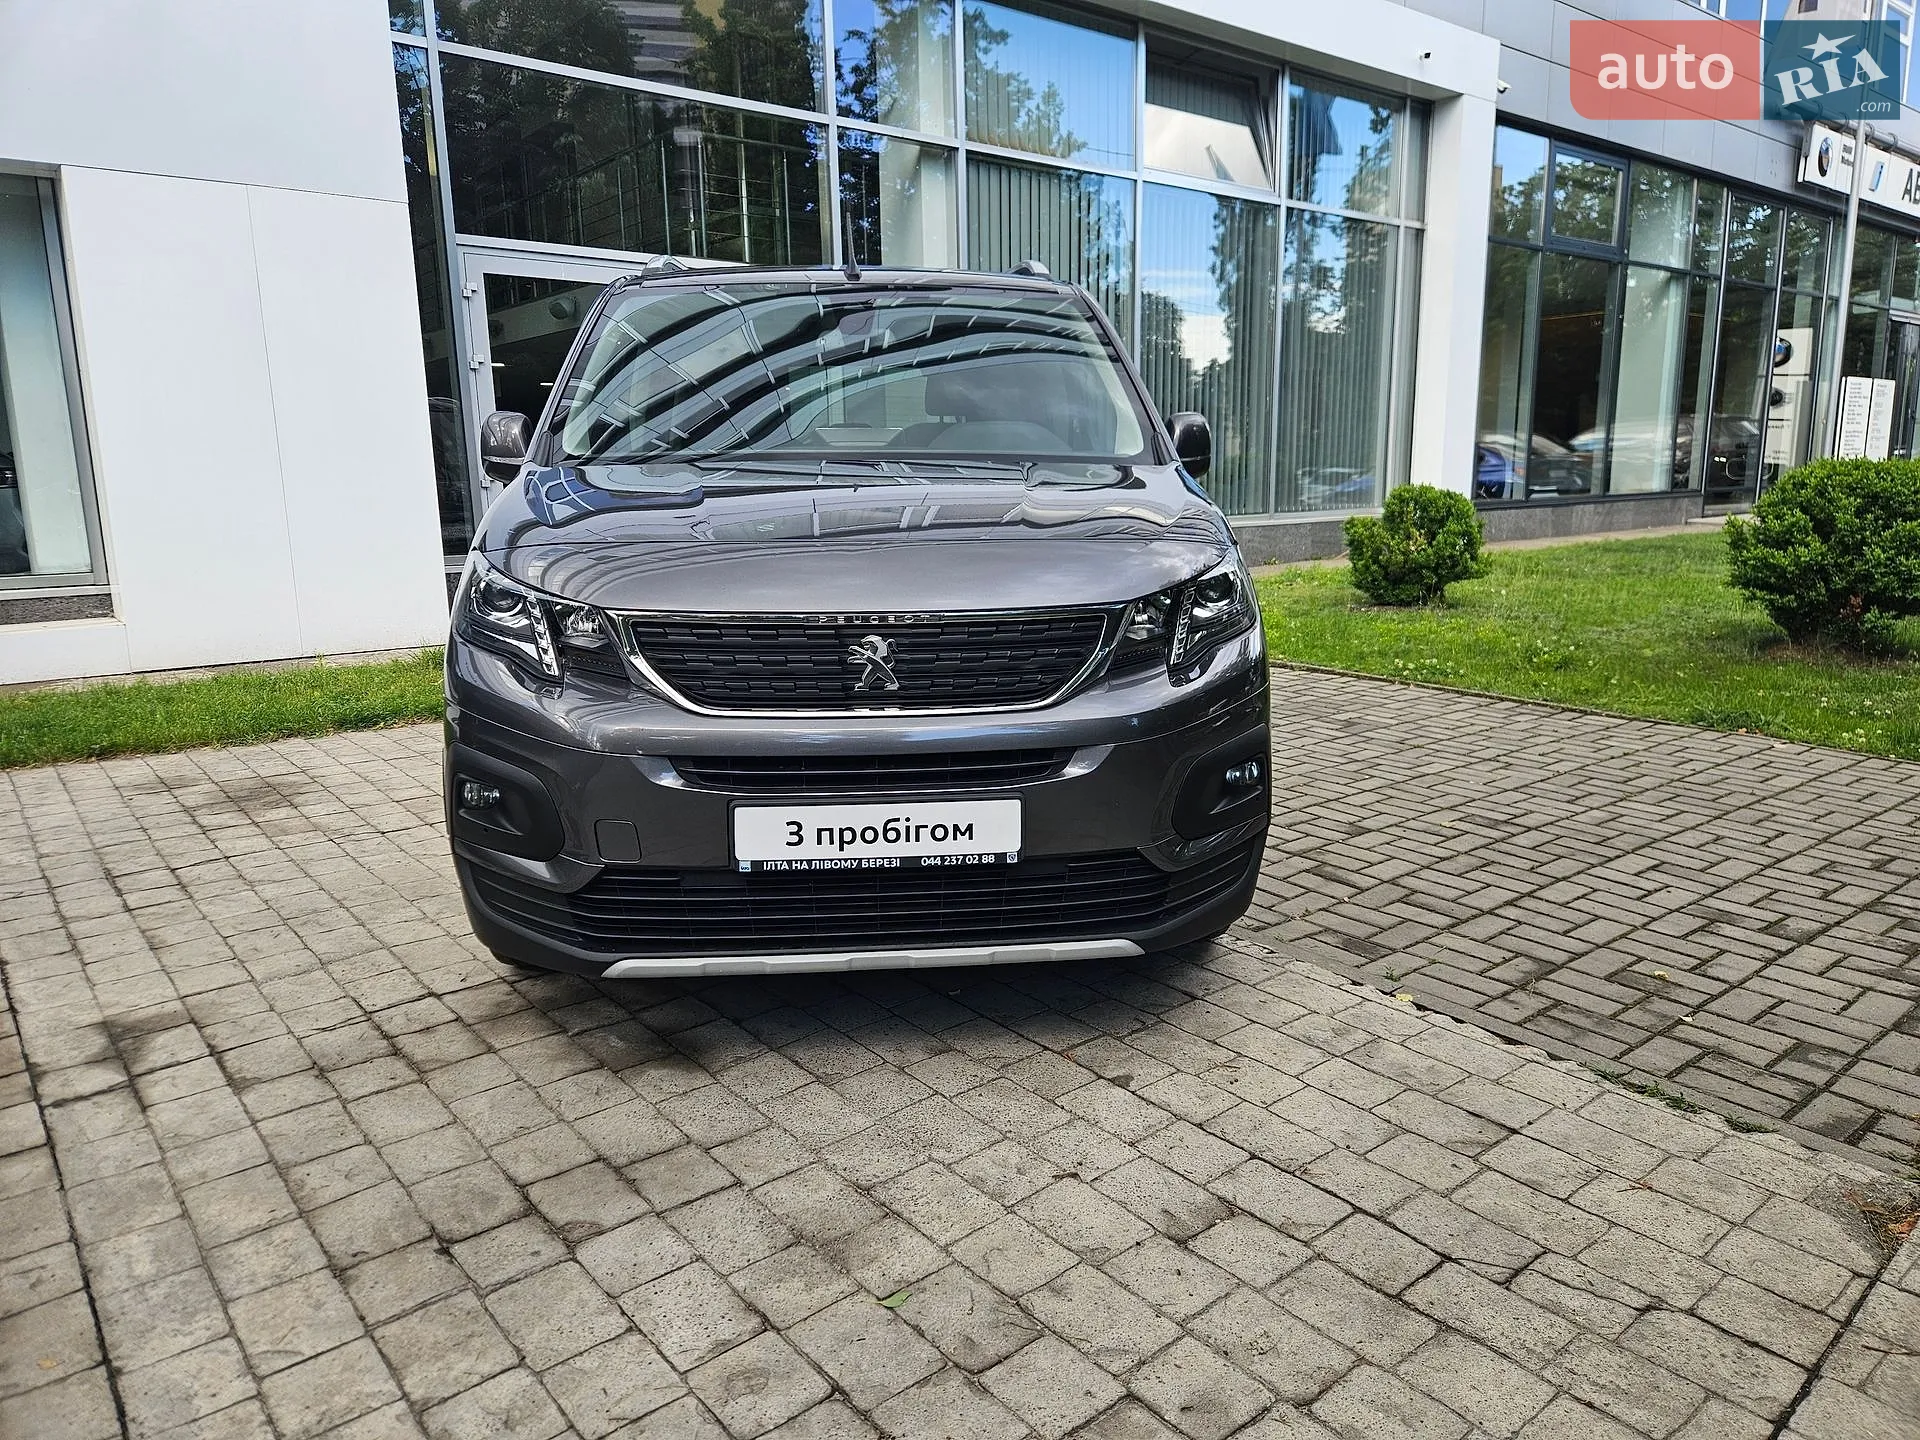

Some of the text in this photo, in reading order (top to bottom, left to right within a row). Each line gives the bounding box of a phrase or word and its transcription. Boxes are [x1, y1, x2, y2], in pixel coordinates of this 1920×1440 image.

[819, 615, 930, 624] PEUGEOT
[816, 816, 974, 852] пробігом
[763, 854, 995, 871] ІЛТА НА ЛІВОМУ БЕРЕЗІ 044 237 02 88
